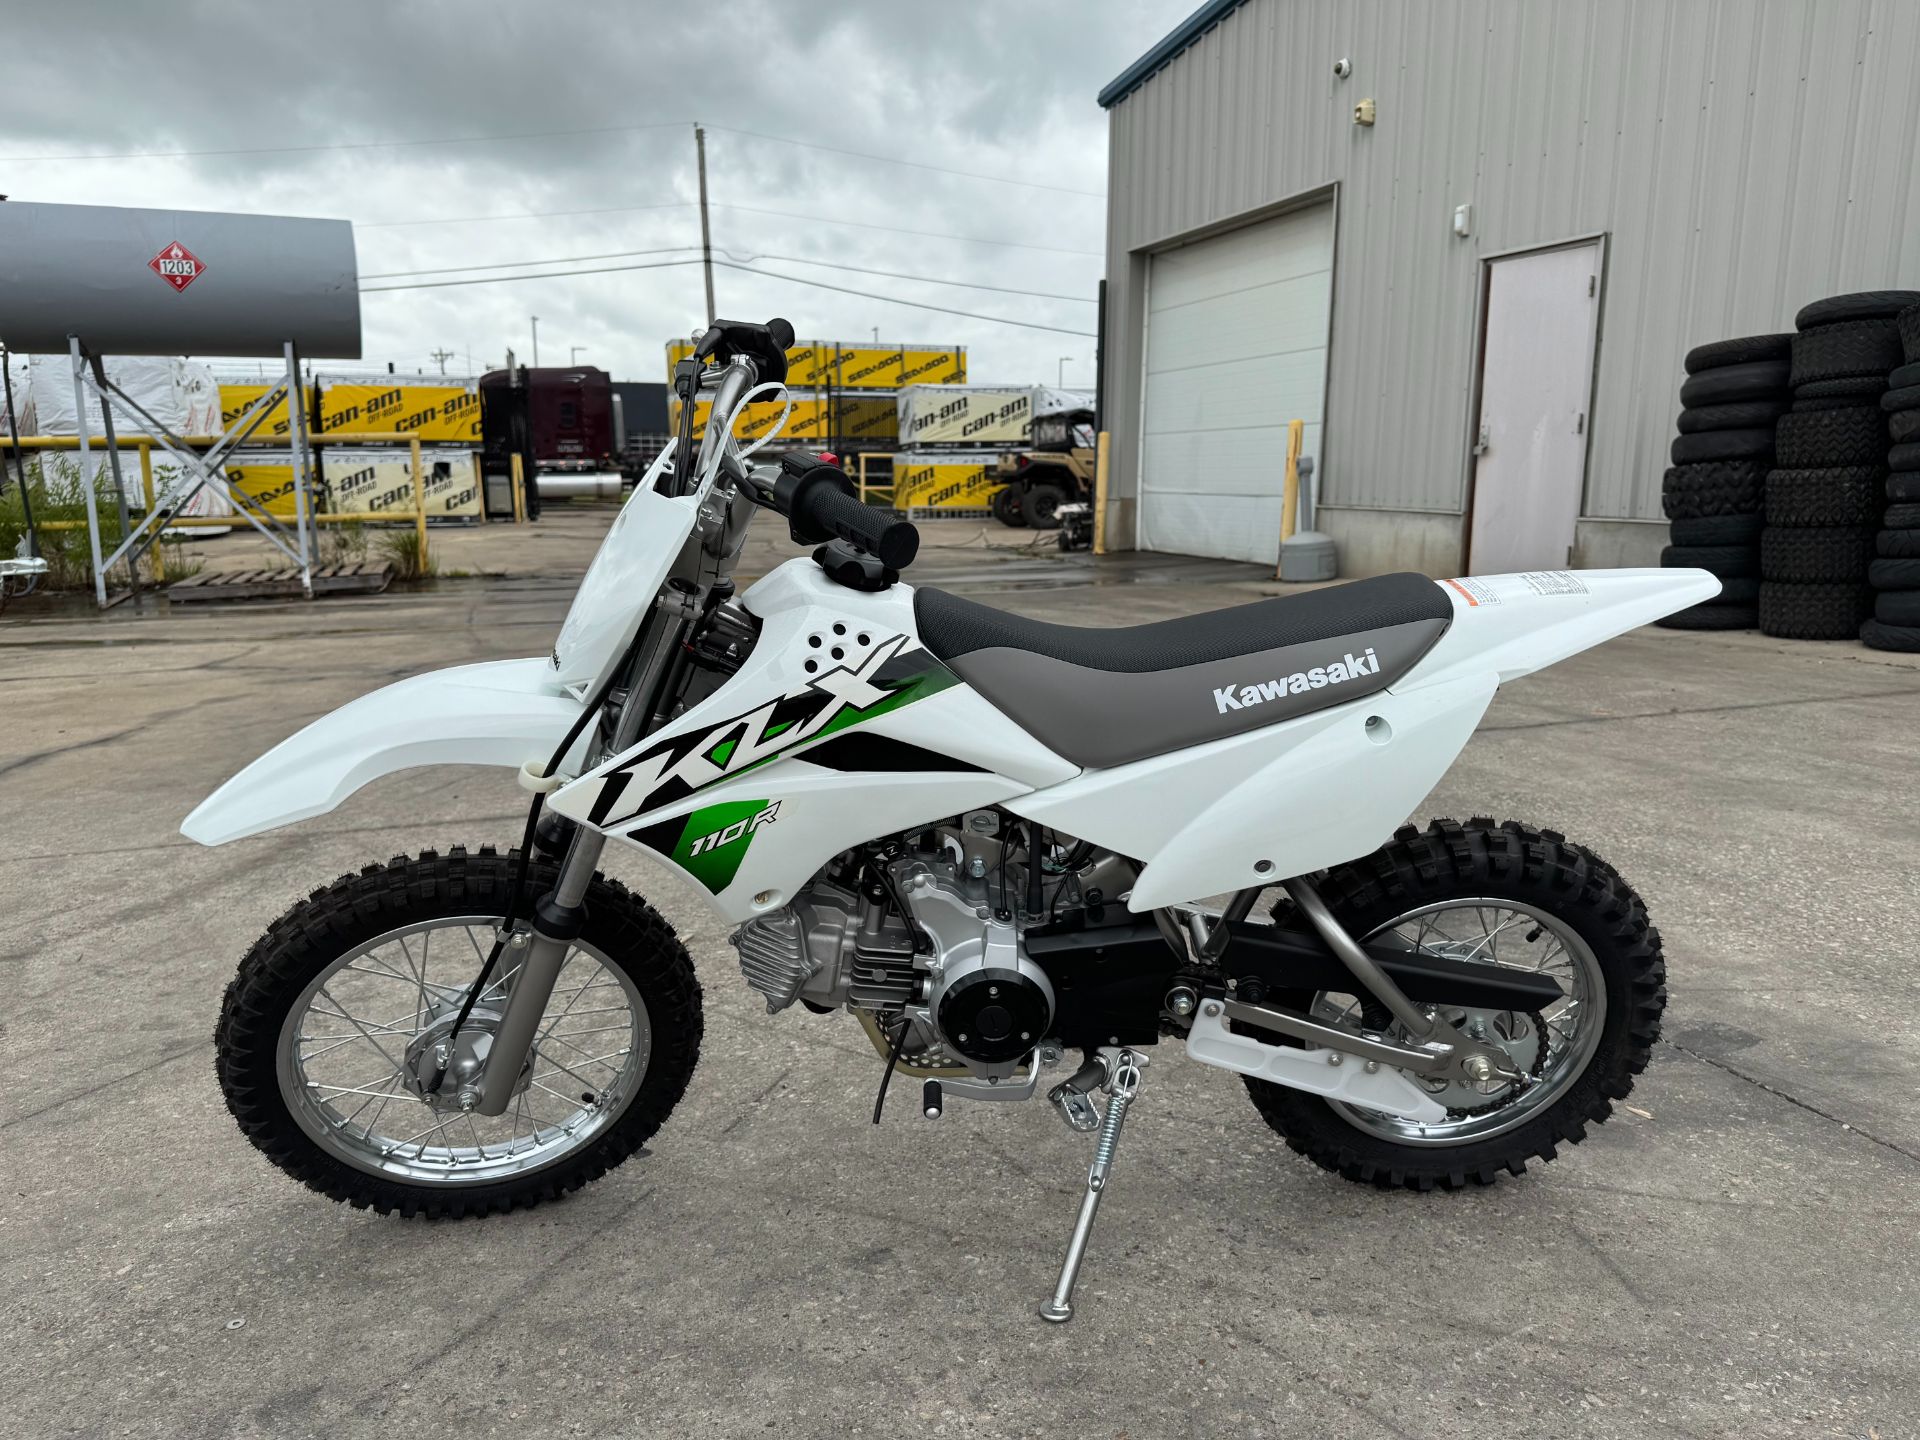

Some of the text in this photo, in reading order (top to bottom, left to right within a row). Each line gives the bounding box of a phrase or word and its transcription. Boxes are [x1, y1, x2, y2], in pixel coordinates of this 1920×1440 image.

[162, 260, 193, 274] 1203
[175, 276, 182, 285] 3
[367, 403, 404, 424] OFF-ROAD
[444, 406, 479, 425] OFF-ROAD
[962, 396, 1028, 437] can-am
[341, 482, 378, 502] OFF-ROAD
[1213, 648, 1380, 714] Kawasaki
[588, 634, 912, 827] KLX
[689, 800, 782, 858] 110R
